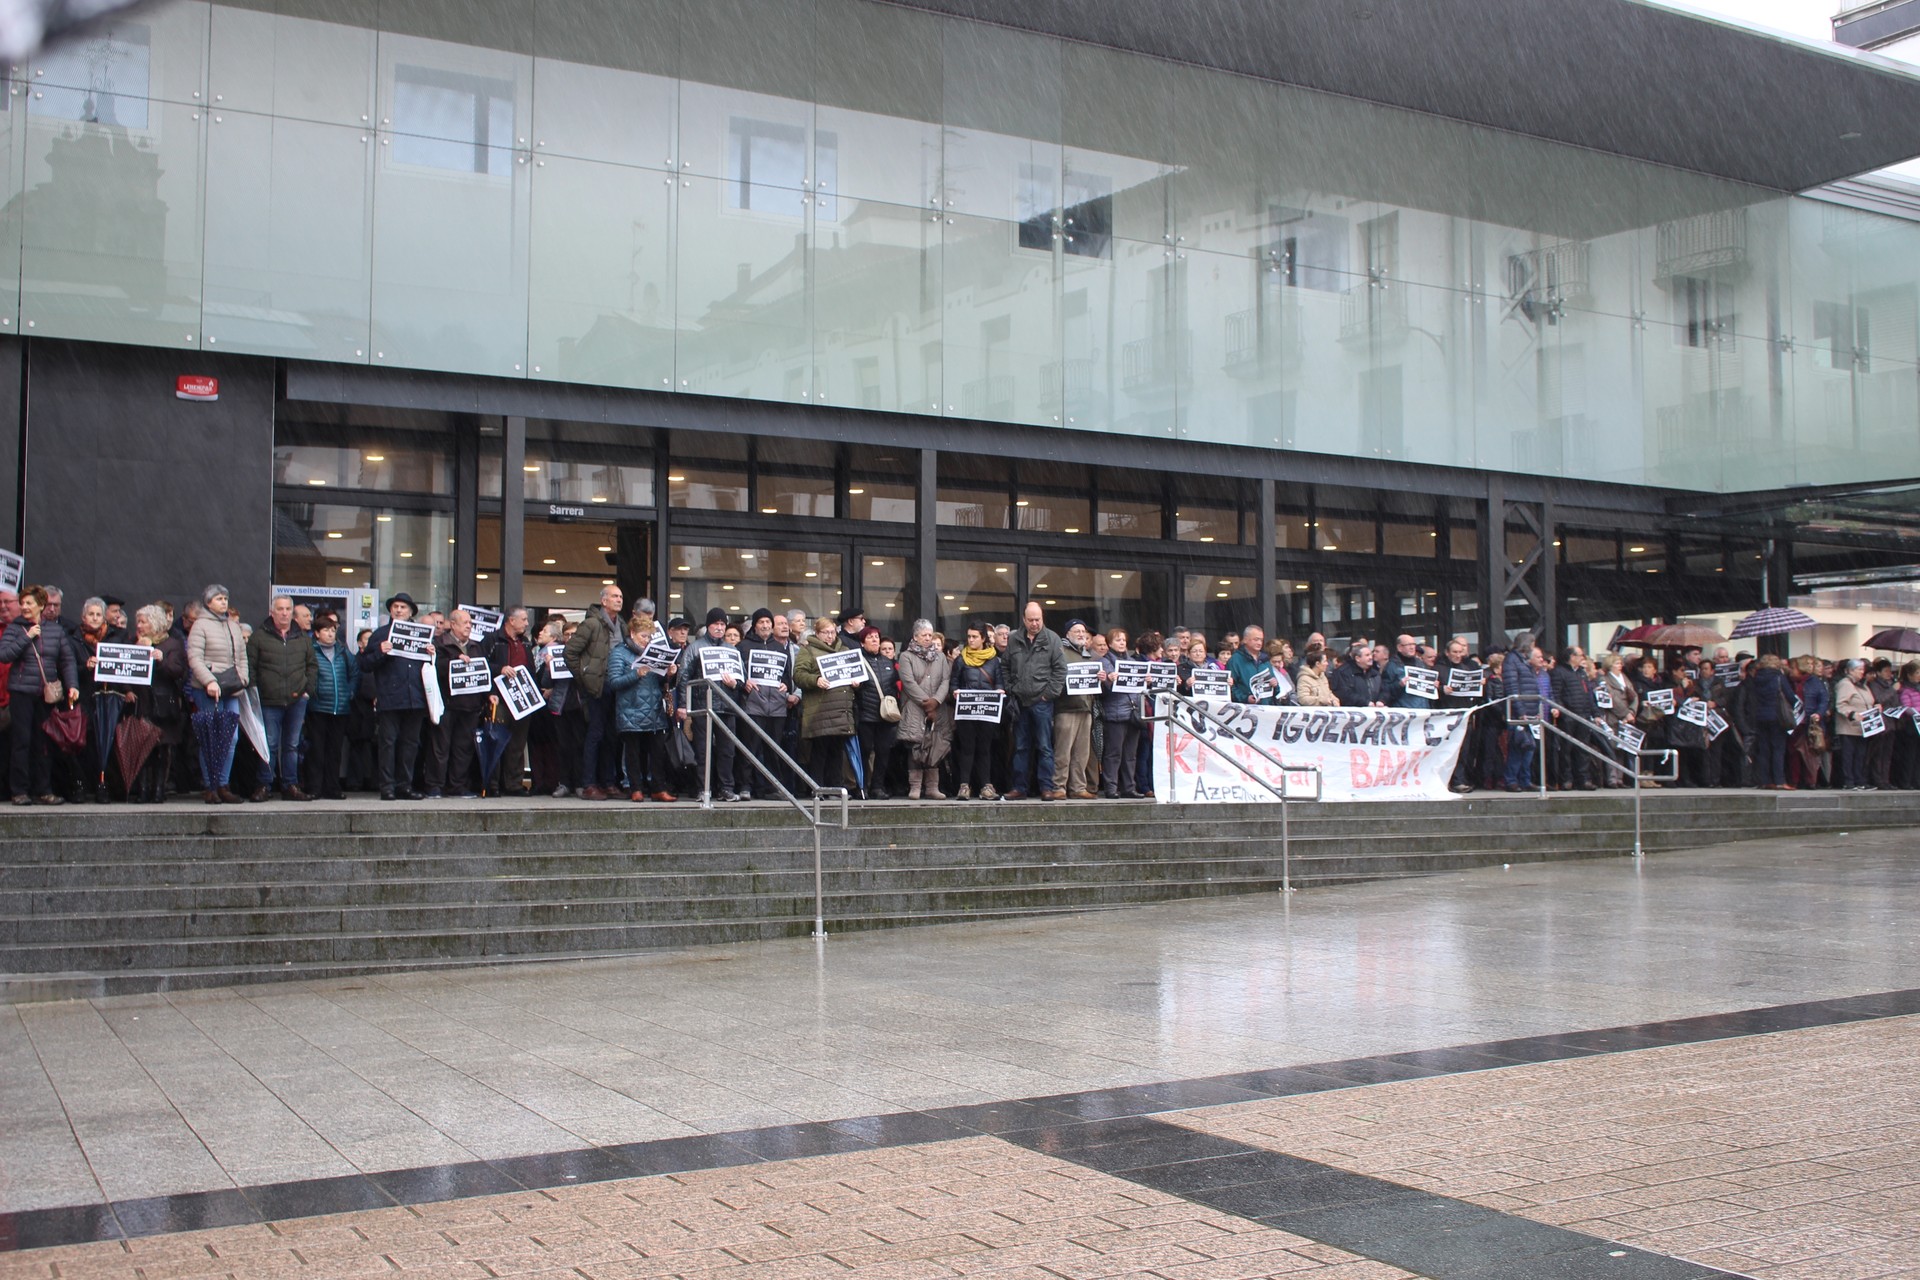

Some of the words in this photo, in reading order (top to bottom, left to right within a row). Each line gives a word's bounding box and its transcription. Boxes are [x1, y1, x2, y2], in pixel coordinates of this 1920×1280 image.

[550, 504, 584, 516] Sarrera
[277, 587, 350, 596] www.selhosvi.com
[392, 637, 406, 646] KPI
[101, 661, 116, 670] KPI
[752, 666, 765, 674] KPI
[825, 669, 838, 678] KPI
[453, 676, 466, 684] KPI
[1272, 710, 1417, 746] IGOERARI
